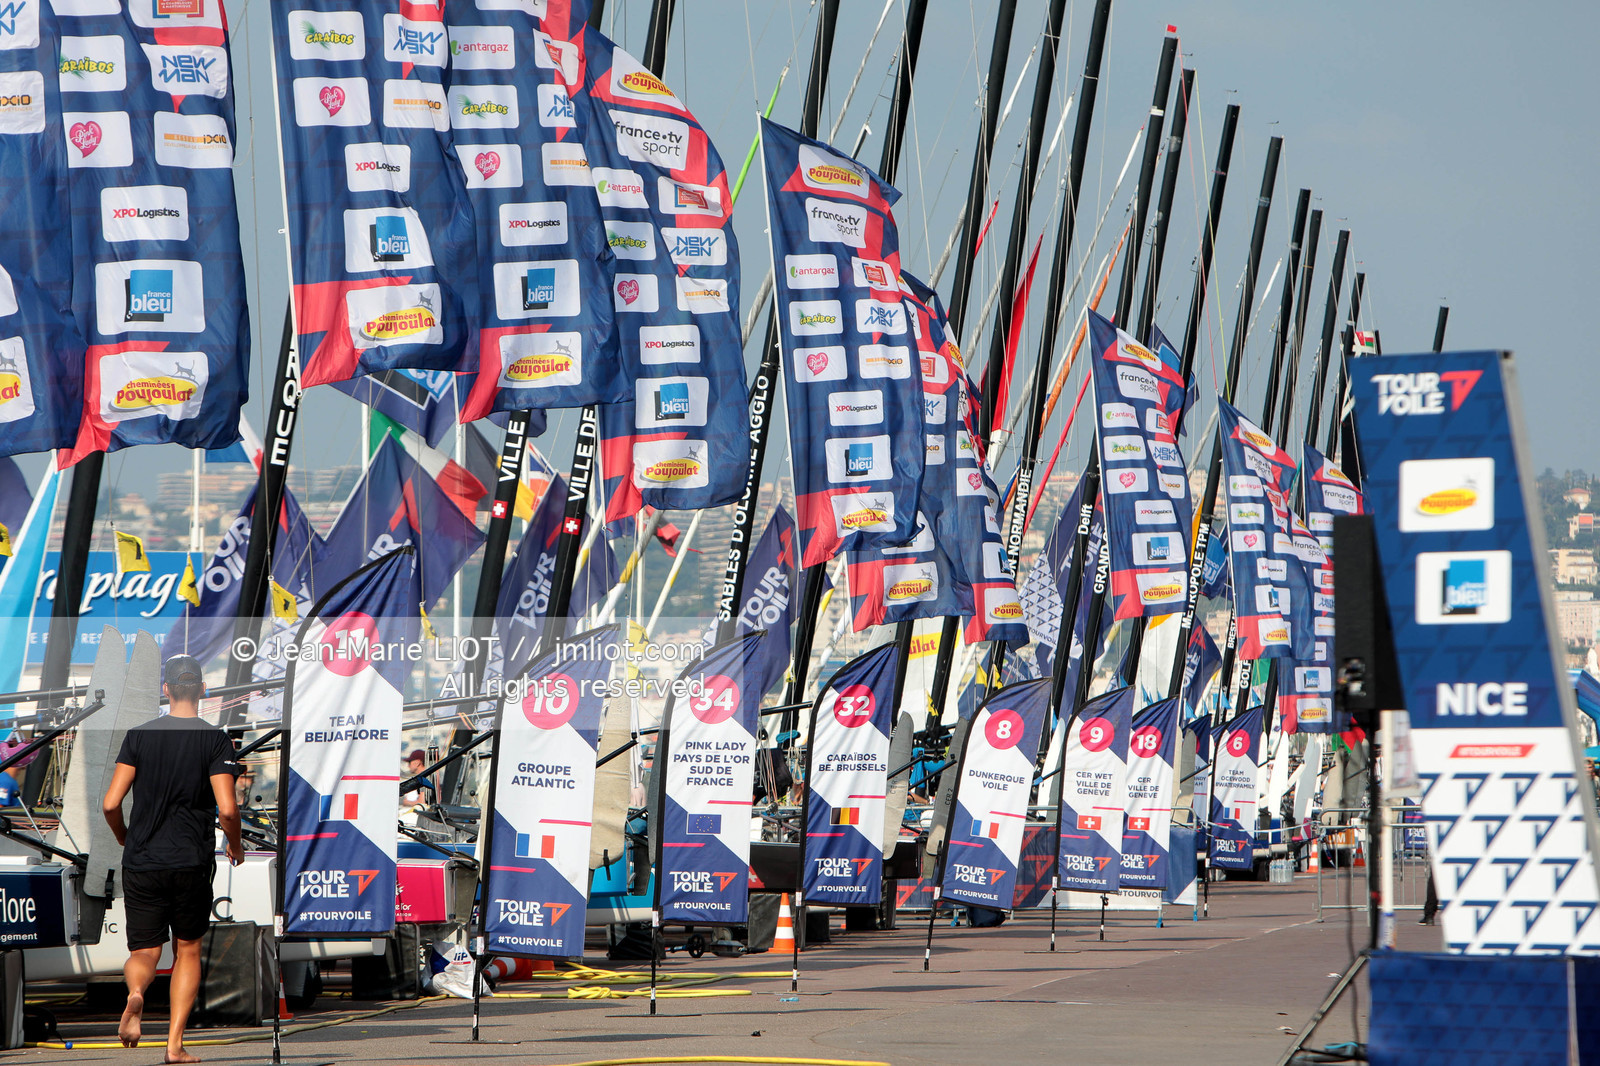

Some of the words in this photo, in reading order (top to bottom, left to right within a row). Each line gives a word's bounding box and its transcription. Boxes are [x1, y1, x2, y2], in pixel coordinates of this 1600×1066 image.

[305, 30, 355, 45] CARAÏBOS
[463, 43, 509, 53] antargaz
[59, 57, 115, 74] ARAÏBOS
[462, 101, 509, 115] CARAÏBOS
[77, 127, 94, 142] Pink
[643, 141, 681, 156] sport
[809, 168, 861, 187] Poujoulat
[611, 184, 643, 194] antarga
[837, 224, 859, 236] sport
[378, 239, 410, 254] bleu
[799, 267, 835, 275] antargaz
[528, 287, 554, 302] bleu
[130, 294, 171, 313] bleu
[366, 313, 436, 334] Poujoulat
[379, 313, 417, 322] cheminées
[508, 359, 570, 378] Poujoulat
[126, 381, 171, 389] cheminées
[1370, 373, 1441, 394] TOUR
[116, 387, 194, 405] Poujoulat
[661, 401, 689, 413] bleu
[1379, 393, 1445, 415] VOILE
[580, 408, 597, 438] DE
[499, 420, 525, 482] VILLE
[646, 465, 698, 478] Poujoulat
[849, 459, 873, 470] bleu
[568, 443, 594, 501] VILLE
[719, 548, 742, 622] SABLES
[750, 375, 769, 443] AGGLO
[1078, 504, 1093, 535] Delft
[1151, 547, 1169, 557] bleu
[510, 552, 555, 629] TOUR
[739, 567, 787, 627] TOUR
[1143, 588, 1181, 598] Poujoulat
[1450, 586, 1488, 606] bleu
[533, 687, 570, 715] 10
[694, 688, 734, 711] 34
[838, 695, 870, 716] 32
[1436, 683, 1528, 716] NICE
[329, 715, 365, 727] TEAM
[305, 729, 389, 743] BEIJAFLORE
[996, 720, 1011, 739] 8
[1090, 727, 1104, 743] 9
[685, 742, 712, 750] PINK
[716, 741, 746, 751] LADY
[1137, 734, 1157, 750] 18
[1233, 737, 1243, 750] 6
[673, 754, 701, 763] PAYS
[705, 754, 720, 763] DE
[827, 752, 877, 762] CARAÏBOS
[518, 763, 571, 775] GROUPE
[690, 766, 713, 775] SUD
[716, 767, 732, 775] DE
[818, 764, 834, 772] BE.
[837, 764, 887, 772] BRUSSELS
[511, 775, 575, 789] ATLANTIC
[687, 777, 734, 786] FRANCE
[969, 769, 1025, 784] DUNKERQUE
[982, 780, 1009, 791] VOILE
[814, 858, 849, 867] TOUR
[1064, 855, 1093, 864] TOUR
[1067, 862, 1095, 871] VOILE
[297, 870, 345, 884] TOUR
[669, 871, 711, 882] TOUR
[817, 867, 852, 877] VOILE
[953, 864, 985, 876] TOUR
[955, 873, 986, 885] VOILE
[300, 884, 350, 898] VOILE
[674, 882, 714, 893] VOILE
[954, 889, 998, 900] #TOURVOILE
[495, 899, 540, 914] TOUR
[674, 902, 731, 910] #TOURVOILE
[300, 911, 371, 921] #TOURVOILE
[500, 912, 544, 927] VOILE
[498, 936, 563, 947] #TOURVOILE
